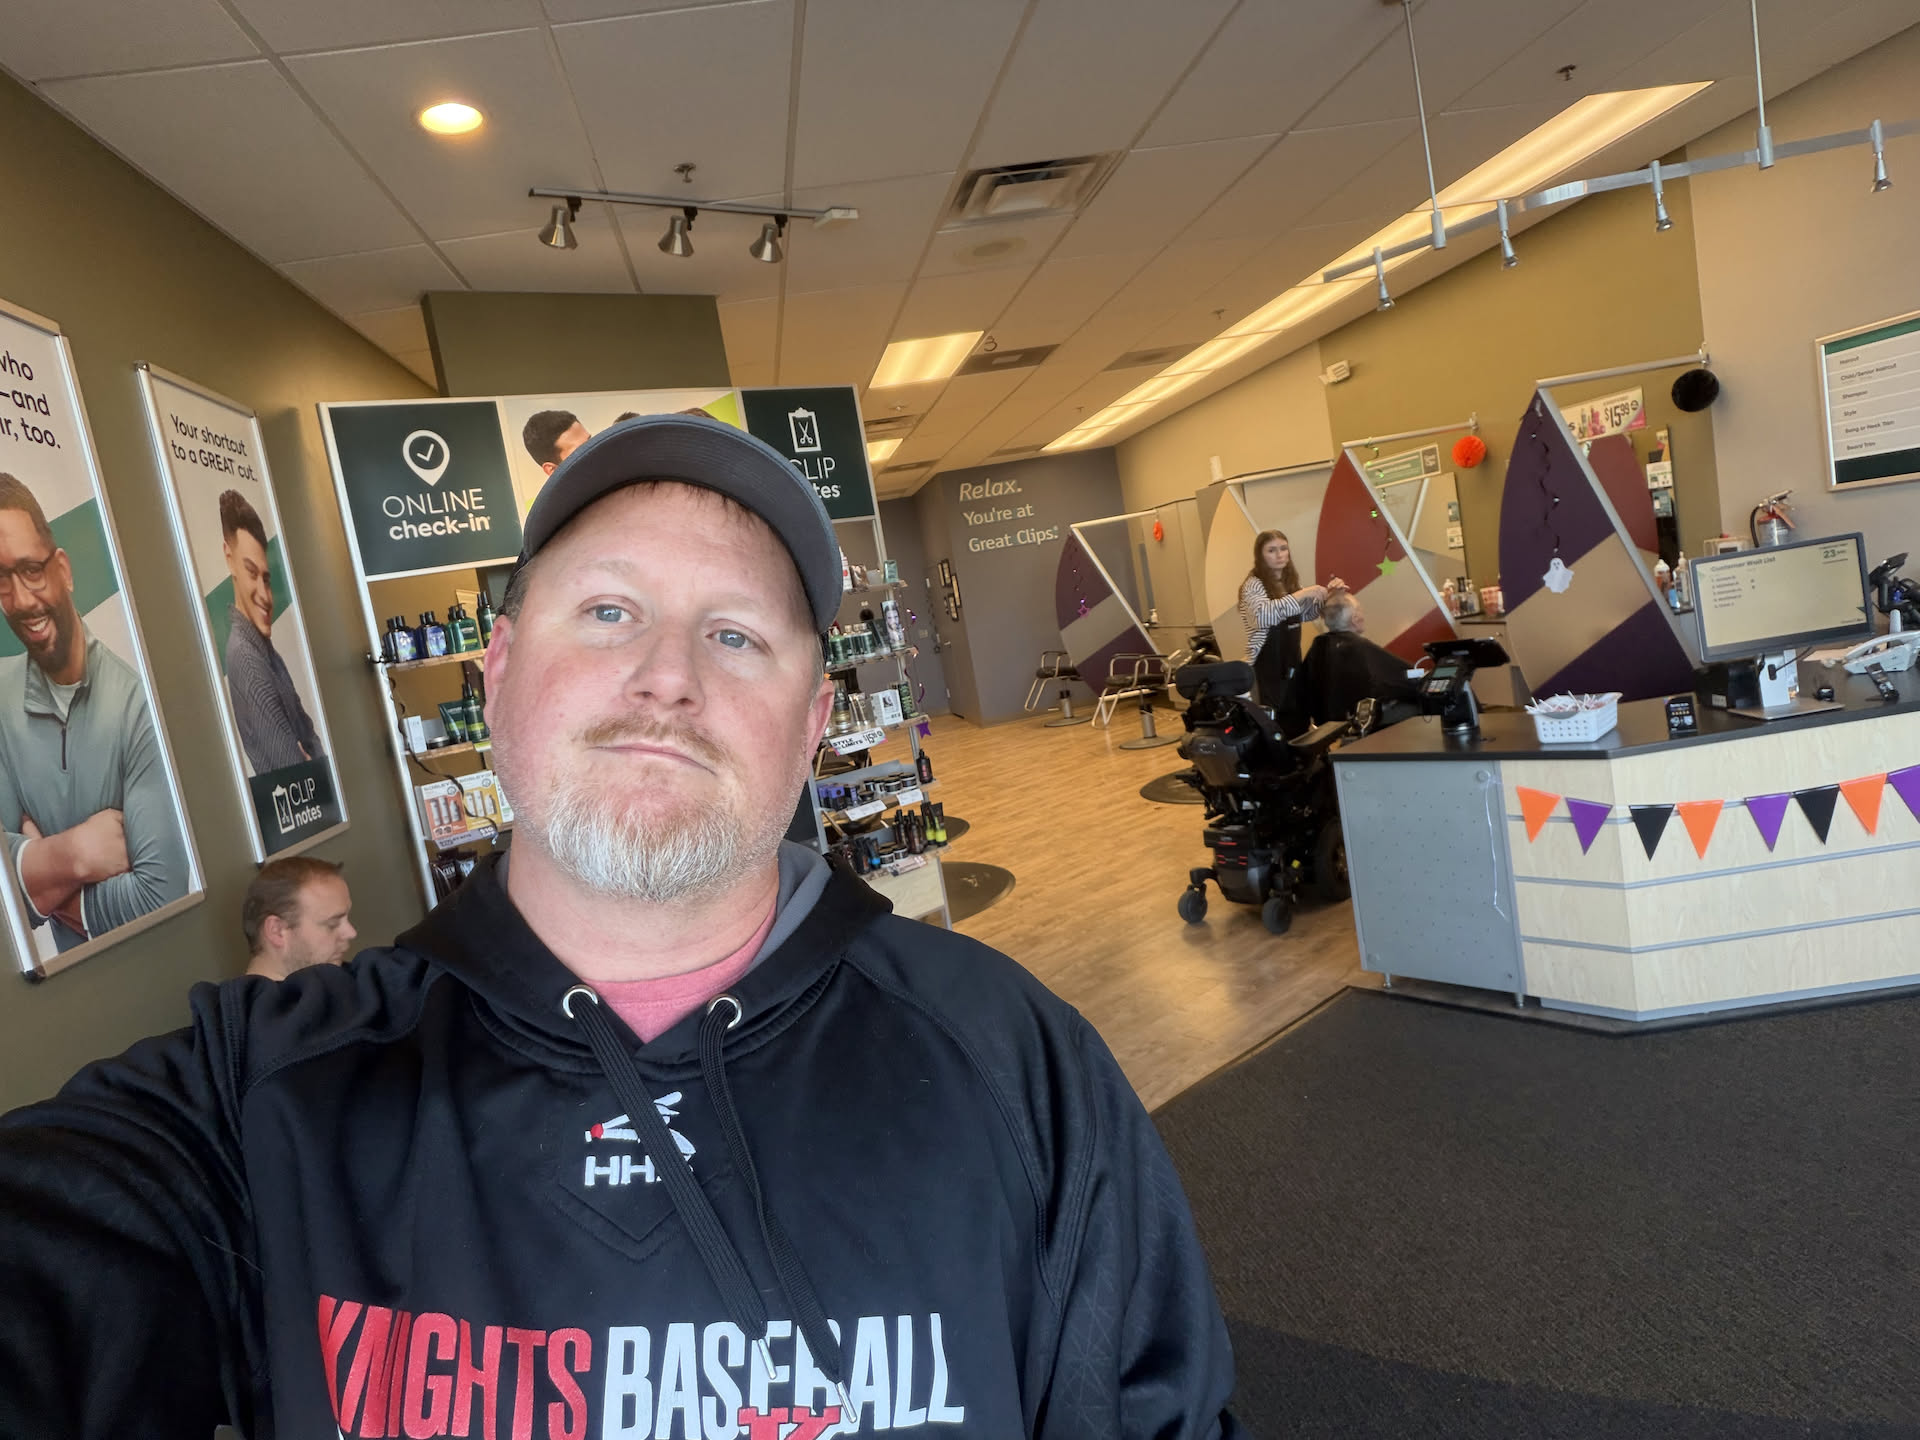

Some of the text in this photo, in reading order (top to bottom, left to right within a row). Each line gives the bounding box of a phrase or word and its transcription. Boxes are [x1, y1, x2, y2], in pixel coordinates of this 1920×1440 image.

[20, 417, 61, 449] too.
[170, 413, 247, 457] Your shortcut
[171, 439, 259, 482] to a GREAT cut.
[382, 487, 485, 518] ONLINE
[812, 482, 842, 499] tes
[960, 478, 1022, 501] Relax.
[389, 512, 491, 541] check-in
[963, 503, 1035, 526] You're at
[968, 533, 1013, 553] Great
[289, 777, 316, 806] CLIP
[295, 804, 322, 827] notes
[585, 1154, 694, 1186] HH
[318, 1294, 592, 1440] KNIGHTS
